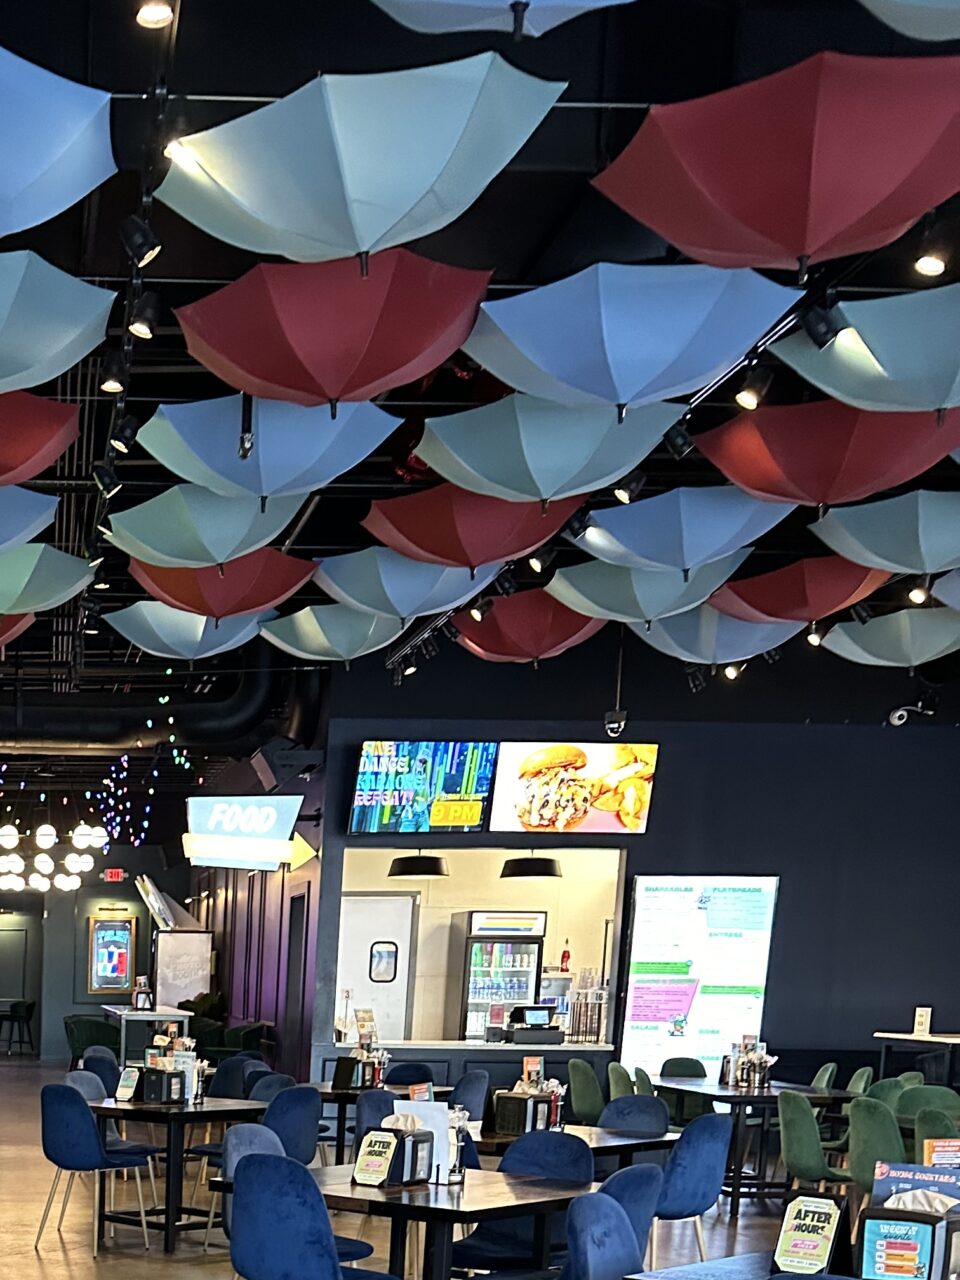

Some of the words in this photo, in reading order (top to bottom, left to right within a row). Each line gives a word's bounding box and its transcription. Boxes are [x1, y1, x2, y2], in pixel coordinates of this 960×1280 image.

[207, 802, 278, 834] FOOD
[432, 804, 445, 821] 9
[447, 804, 479, 822] PM
[367, 1139, 392, 1150] AFTER
[793, 1208, 833, 1225] AFTER
[793, 1222, 827, 1236] HOURS
